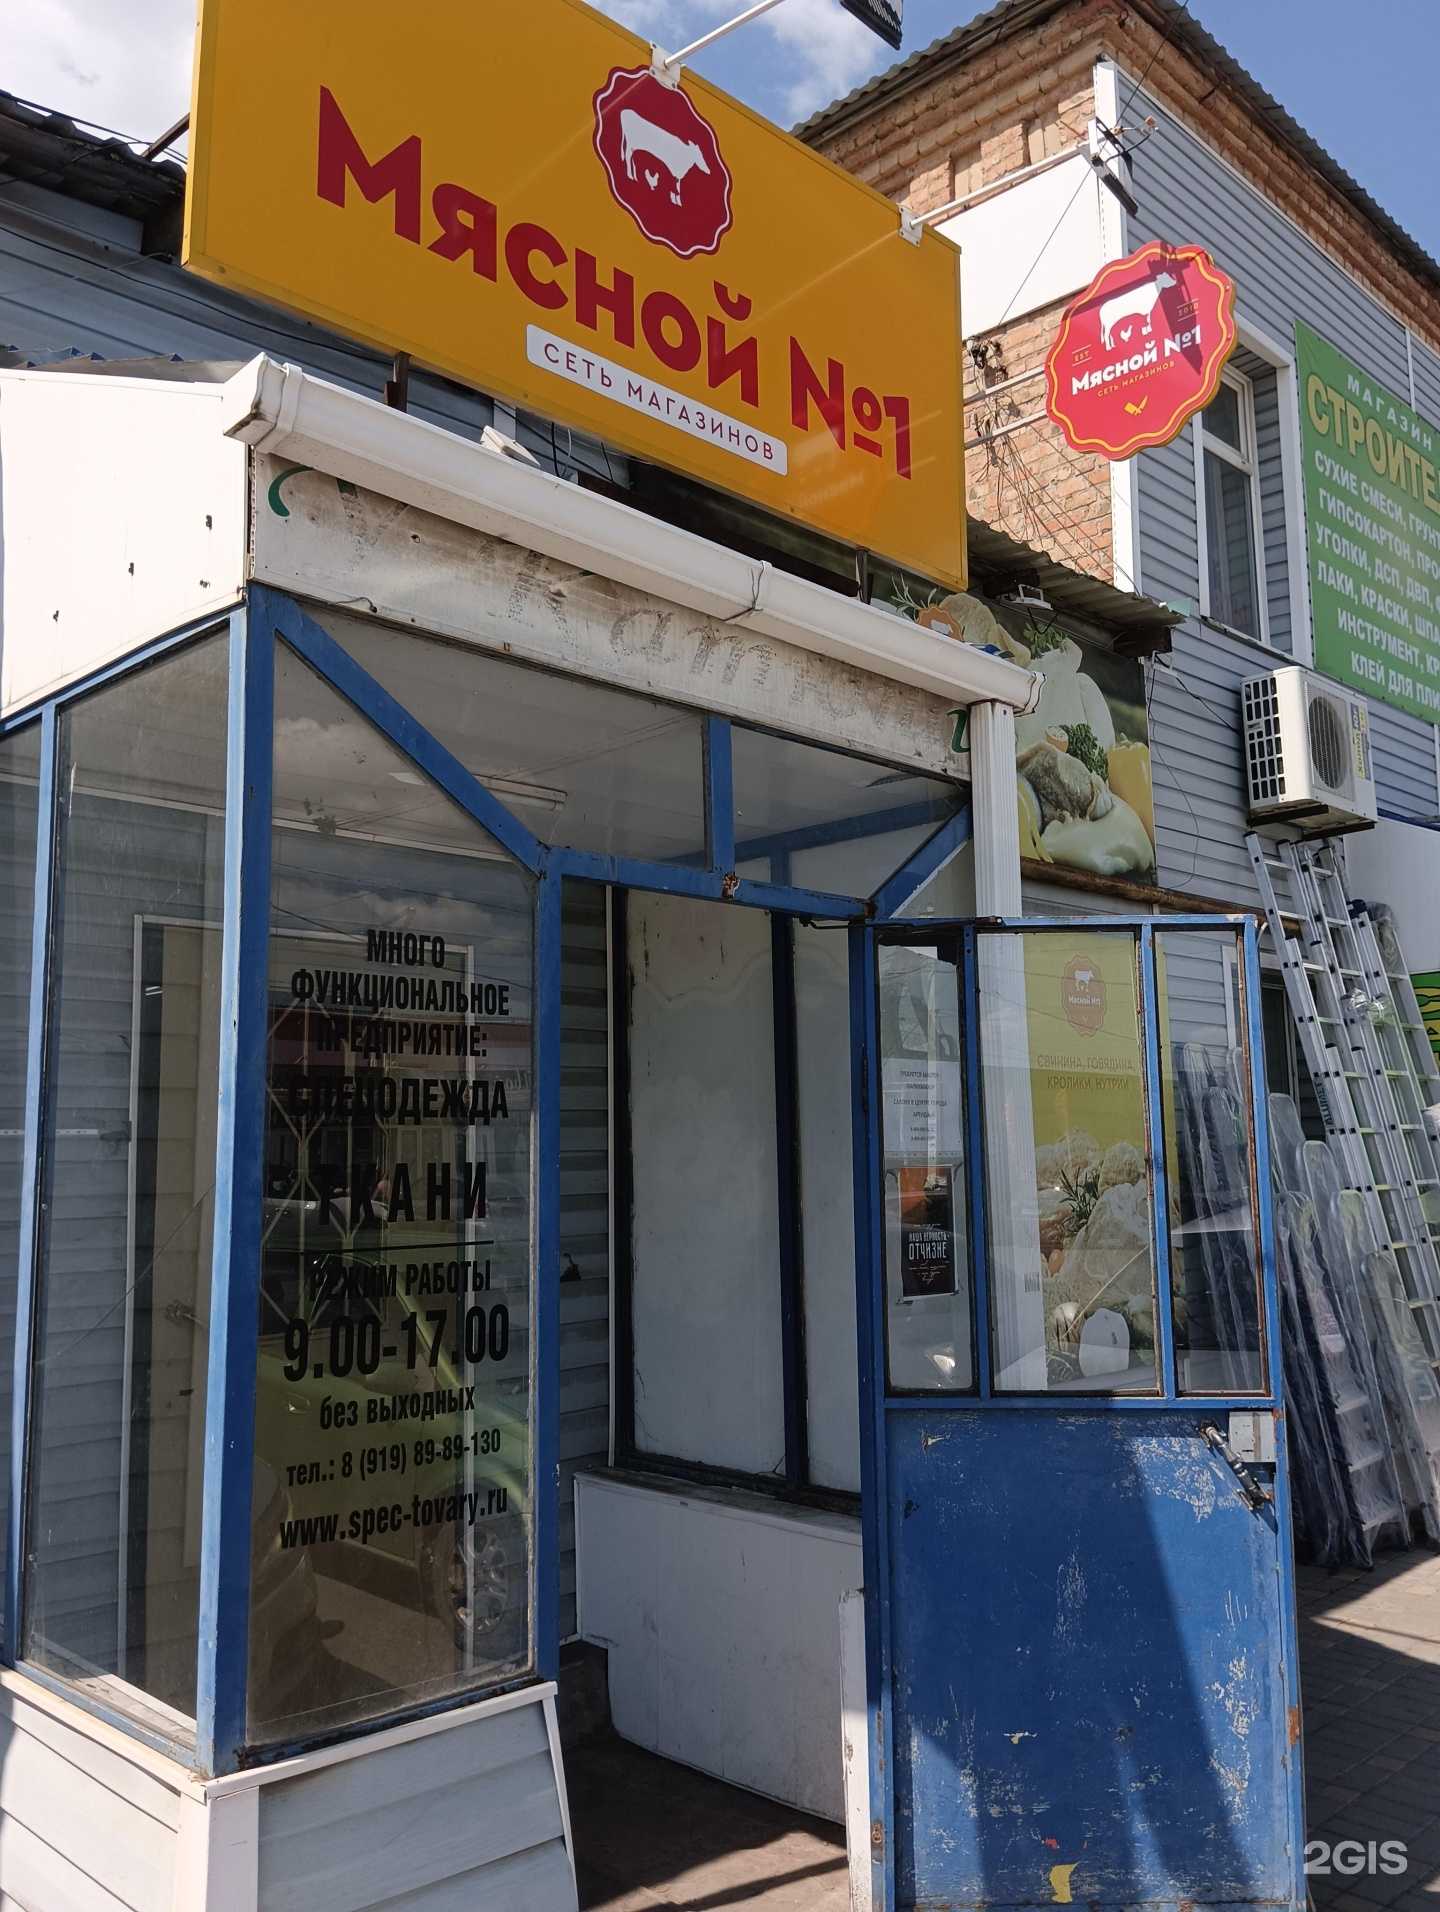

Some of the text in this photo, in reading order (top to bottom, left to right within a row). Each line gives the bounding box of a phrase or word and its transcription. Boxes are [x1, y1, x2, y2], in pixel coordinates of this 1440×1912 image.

[1163, 324, 1201, 358] №1
[543, 342, 776, 463] СЕТЬ МАГАЗИНОВ
[789, 335, 911, 480] №1
[1097, 360, 1175, 397] СЕТЬ МАГАЗИНОВ
[1346, 374, 1432, 452] МАГАЗИН
[1314, 449, 1360, 497] СУХИЕ
[1360, 480, 1407, 532] СМЕСИ,
[1319, 487, 1416, 569] ГИПСОКАРТОН,
[1315, 521, 1371, 578] УГОЛКИ,
[1374, 558, 1404, 596] ДСП,
[1406, 575, 1434, 613] ДВП,
[1317, 559, 1359, 606] ЛАКИ,
[1360, 583, 1413, 636] КРАСКИ,
[1337, 607, 1424, 675] ИНСТРУМЕНТ,
[1351, 650, 1386, 687] КЛЕЙ
[1387, 669, 1414, 698] ДЛЯ
[366, 929, 446, 968] МНОГО
[290, 968, 512, 1017] ФУНКЦИОНАЛЬНОЕ
[317, 1017, 489, 1060] ПРЕДПРИЯТИЕ:
[309, 1260, 491, 1300] РЕЖИМ РАБОТЫ
[908, 1241, 948, 1261] ОТЧИЗНЕ
[283, 1303, 510, 1382] 9.00-17.00
[319, 1386, 476, 1430] без выходных
[286, 1427, 502, 1488] тел.: 8 (919) 89-89-130
[279, 1486, 508, 1550] www.spec-tovary.ru
